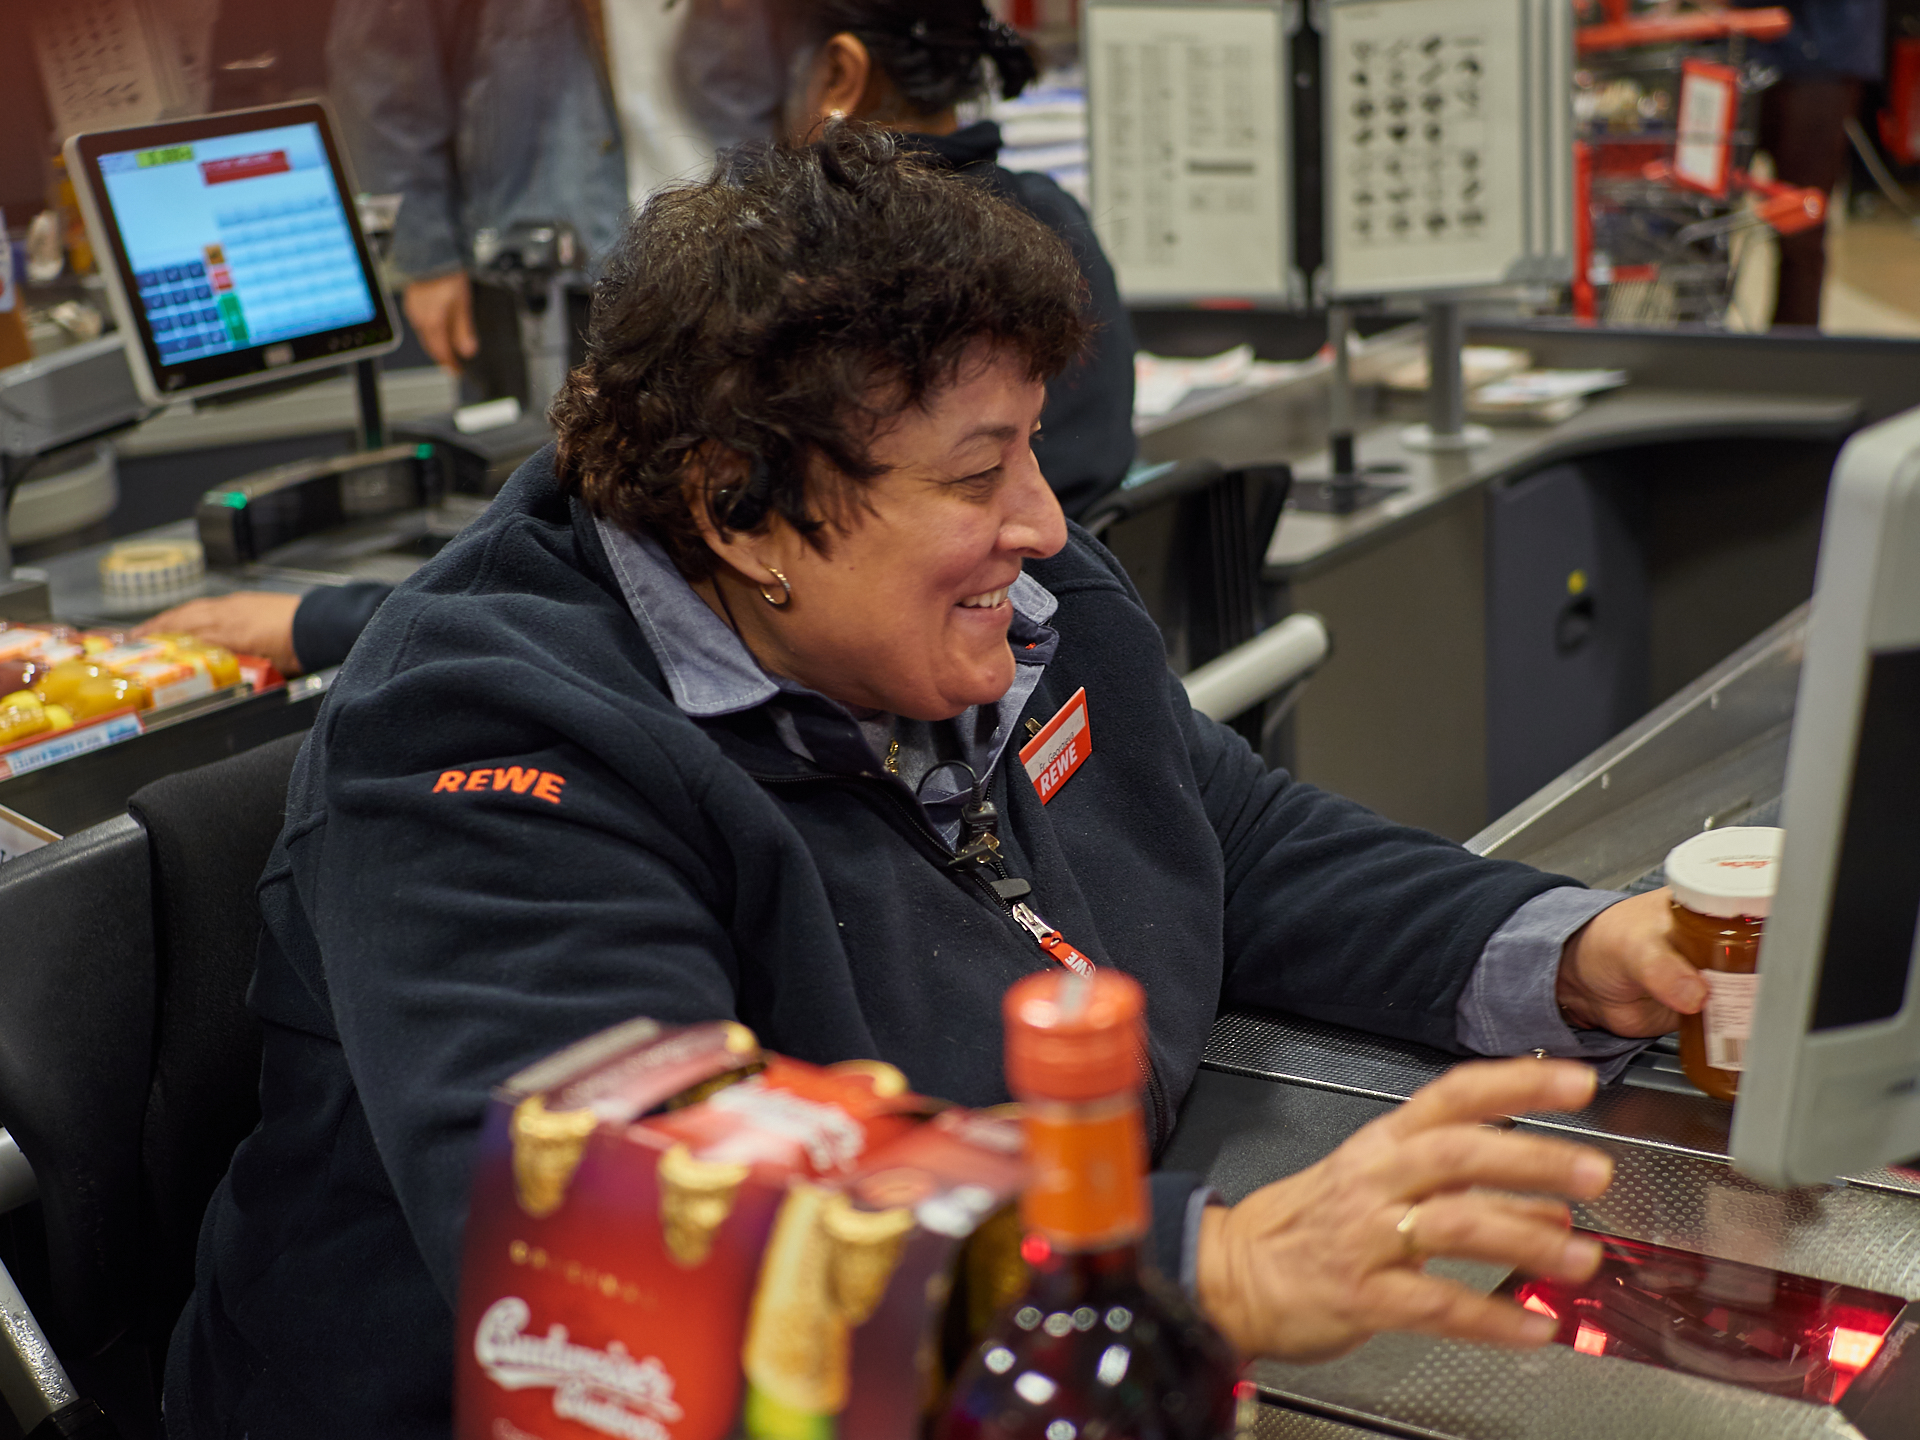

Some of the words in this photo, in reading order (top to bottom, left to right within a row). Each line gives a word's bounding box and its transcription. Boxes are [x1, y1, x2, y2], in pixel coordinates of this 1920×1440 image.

[432, 765, 566, 804] REWE
[1040, 741, 1078, 796] REWE
[1064, 951, 1094, 979] EWE
